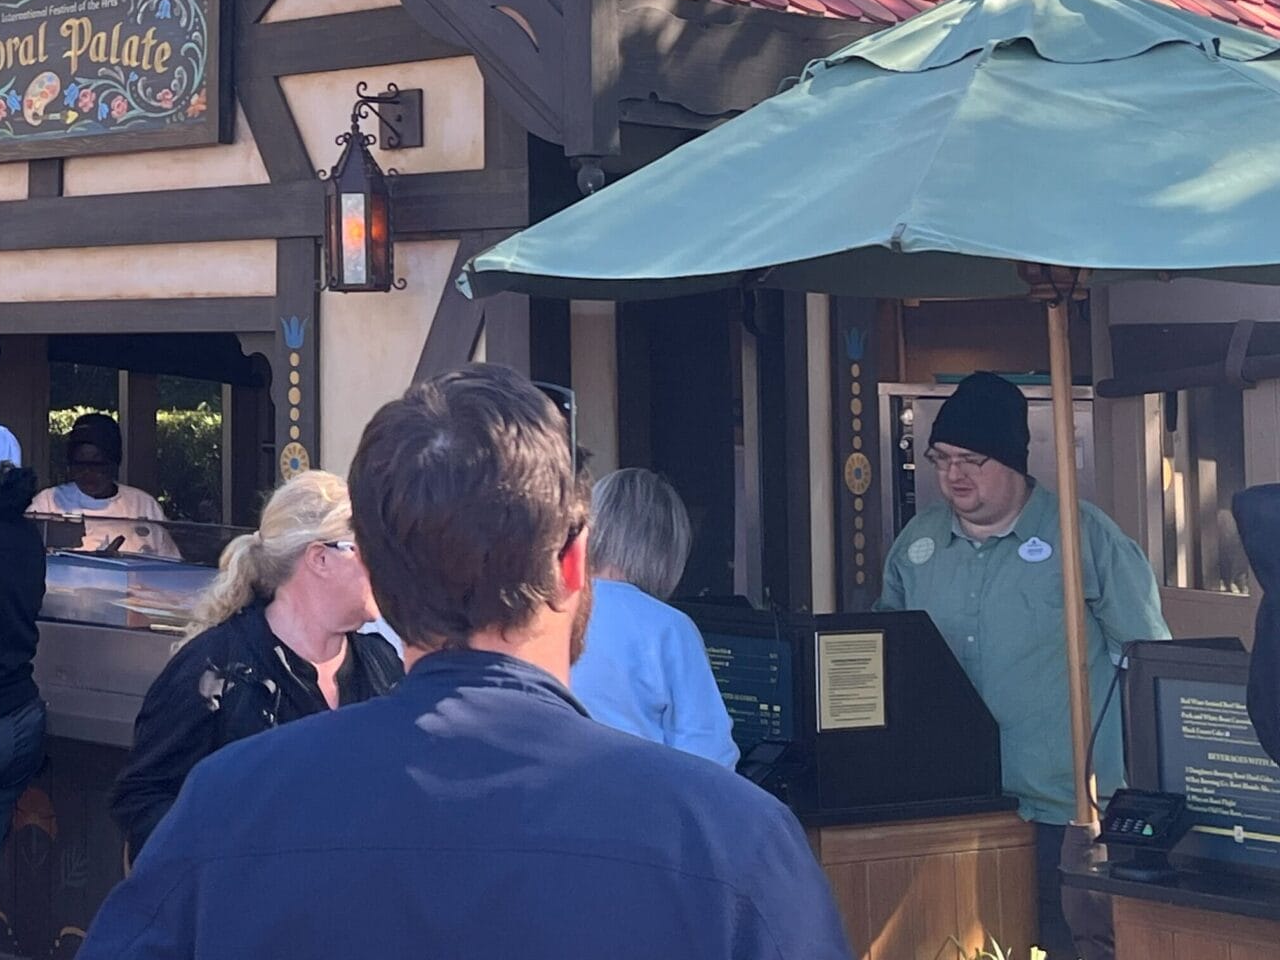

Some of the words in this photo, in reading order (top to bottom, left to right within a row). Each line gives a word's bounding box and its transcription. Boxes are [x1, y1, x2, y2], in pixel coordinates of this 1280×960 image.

[1, 10, 48, 23] International
[49, 1, 77, 16] Festival
[78, 0, 87, 12] of
[60, 17, 172, 75] Palate
